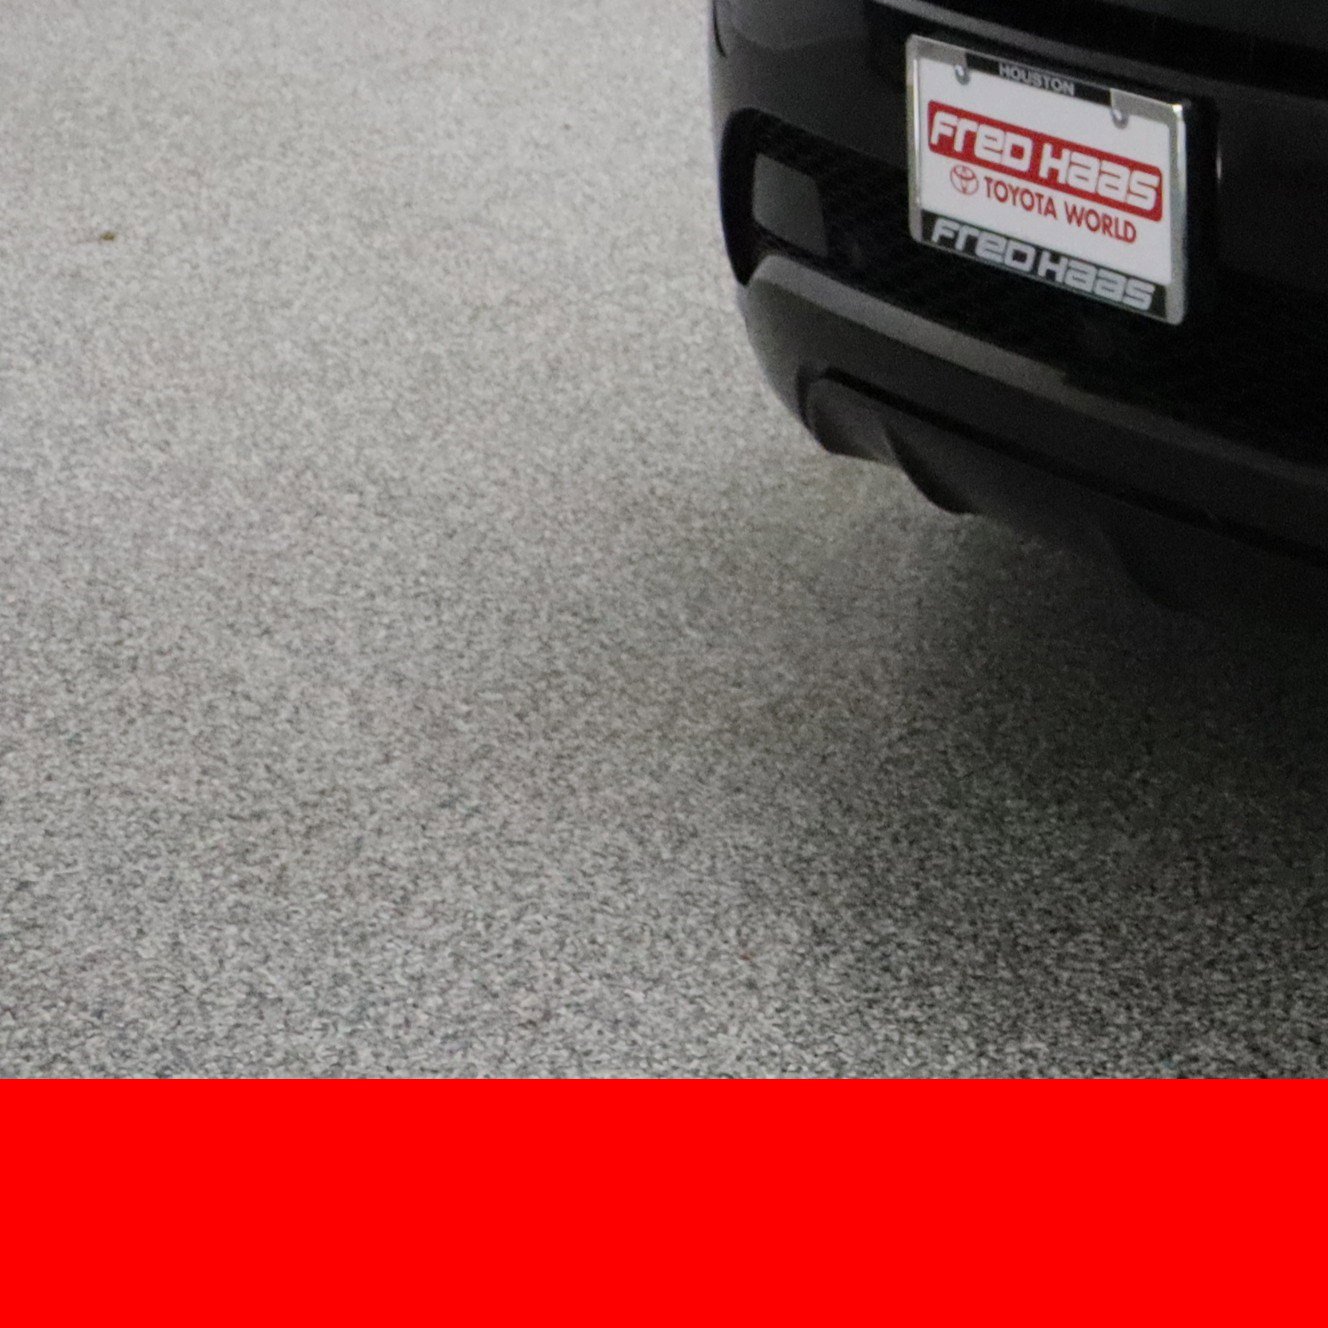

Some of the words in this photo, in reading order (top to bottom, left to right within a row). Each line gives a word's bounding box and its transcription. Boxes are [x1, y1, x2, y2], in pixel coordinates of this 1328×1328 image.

[999, 64, 1075, 96] HOUSTON
[983, 175, 1058, 221] TOYOTA
[1063, 200, 1137, 244] WORLD
